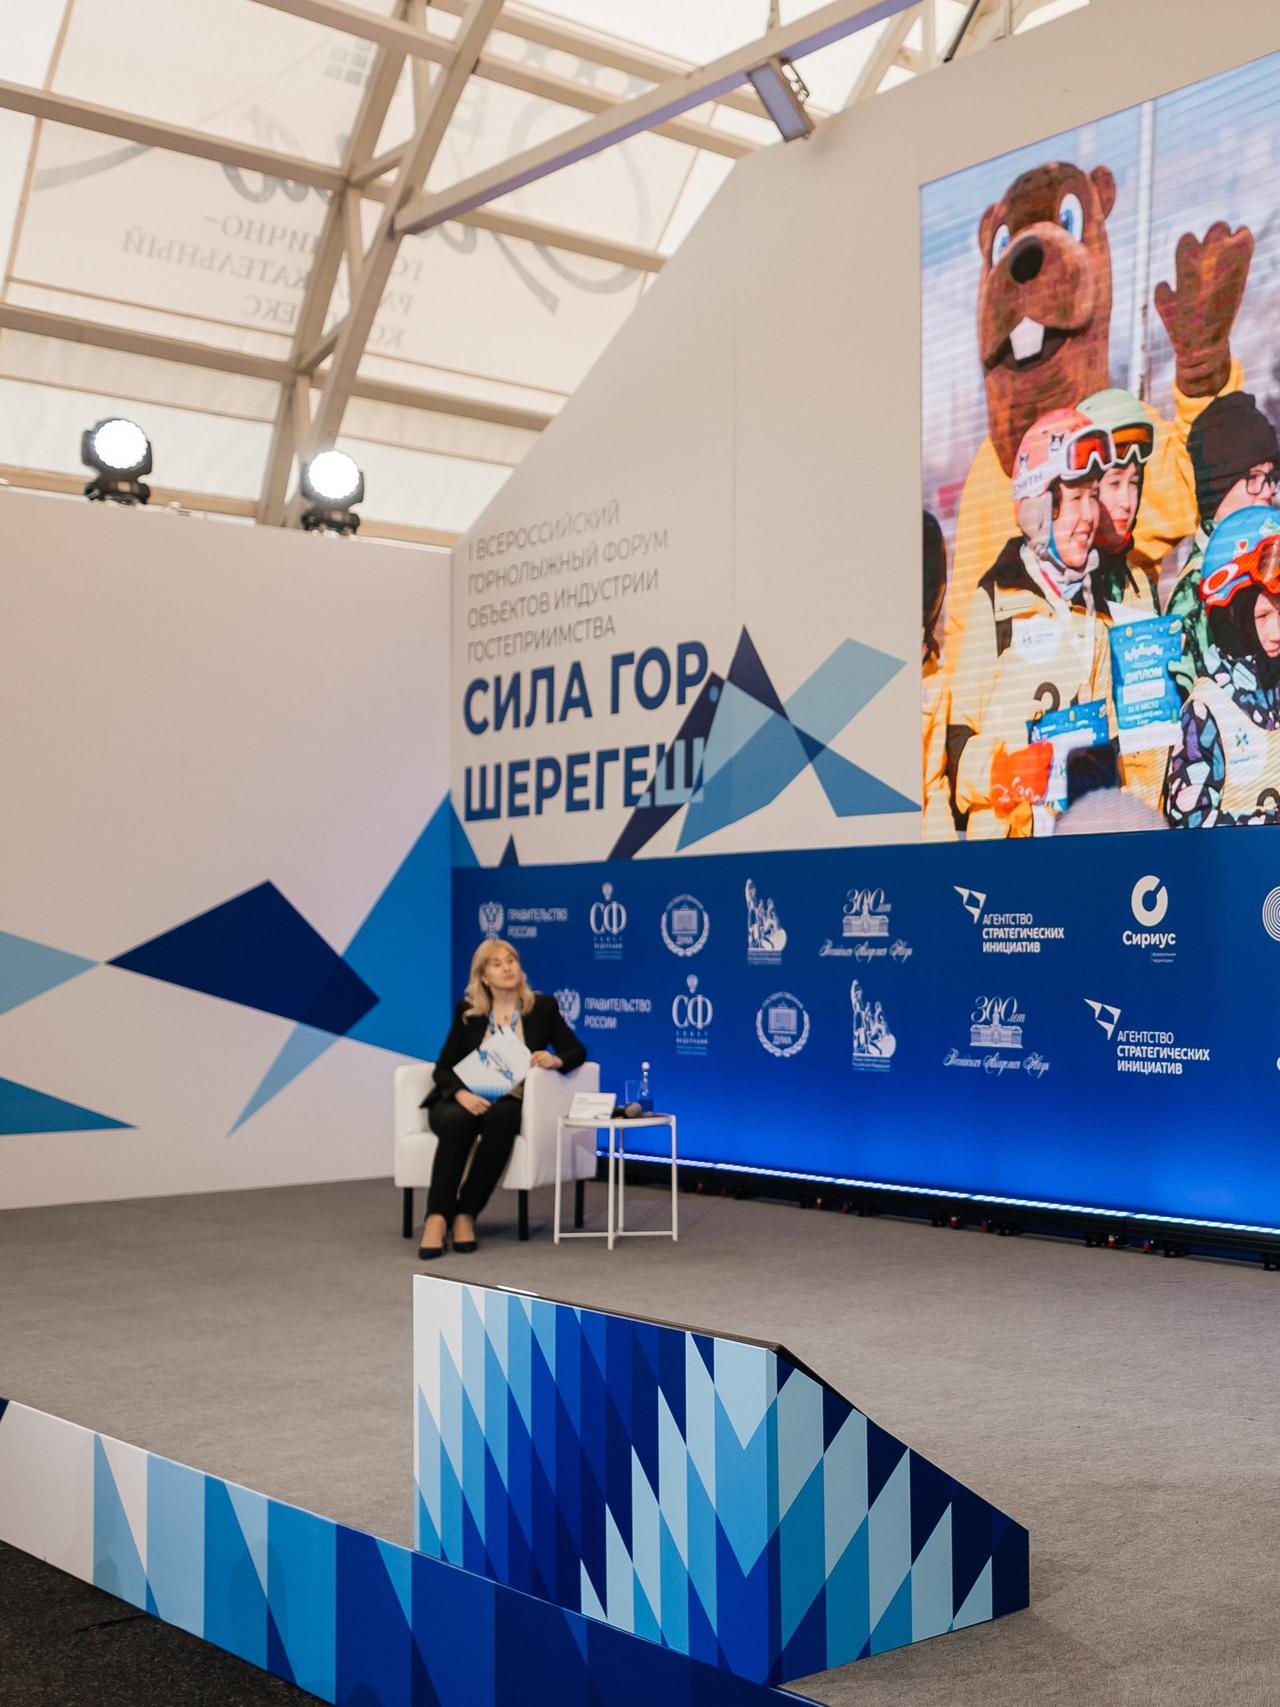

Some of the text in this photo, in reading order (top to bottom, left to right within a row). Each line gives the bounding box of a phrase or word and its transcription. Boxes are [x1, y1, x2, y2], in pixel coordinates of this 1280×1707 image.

[476, 499, 620, 560] ВСЕРОССИЙСКИЙ
[468, 528, 668, 595] ГОРНОЛЫЖНЫЙ ФОРУМ
[467, 568, 658, 630] ОБЪЕКТОВ ИНДУСТРИИ
[467, 614, 615, 663] ГОСТЕПРИИМСТВА
[463, 660, 593, 736] СИЛА
[464, 736, 705, 822] ШЕРЕГЕШ
[983, 913, 1033, 925] АГЕНТСТВО
[982, 927, 1065, 939] СТРАТЕГИЧЕСКИХ
[1122, 930, 1176, 948] Сириус
[983, 941, 1041, 955] ИНИЦИАТИВ
[1117, 1030, 1174, 1044] АГЕНТСТВО
[1117, 1045, 1210, 1061] СТРАТЕГИЧЕСКИХ
[1117, 1060, 1183, 1075] ИНИЦИАТИВ
